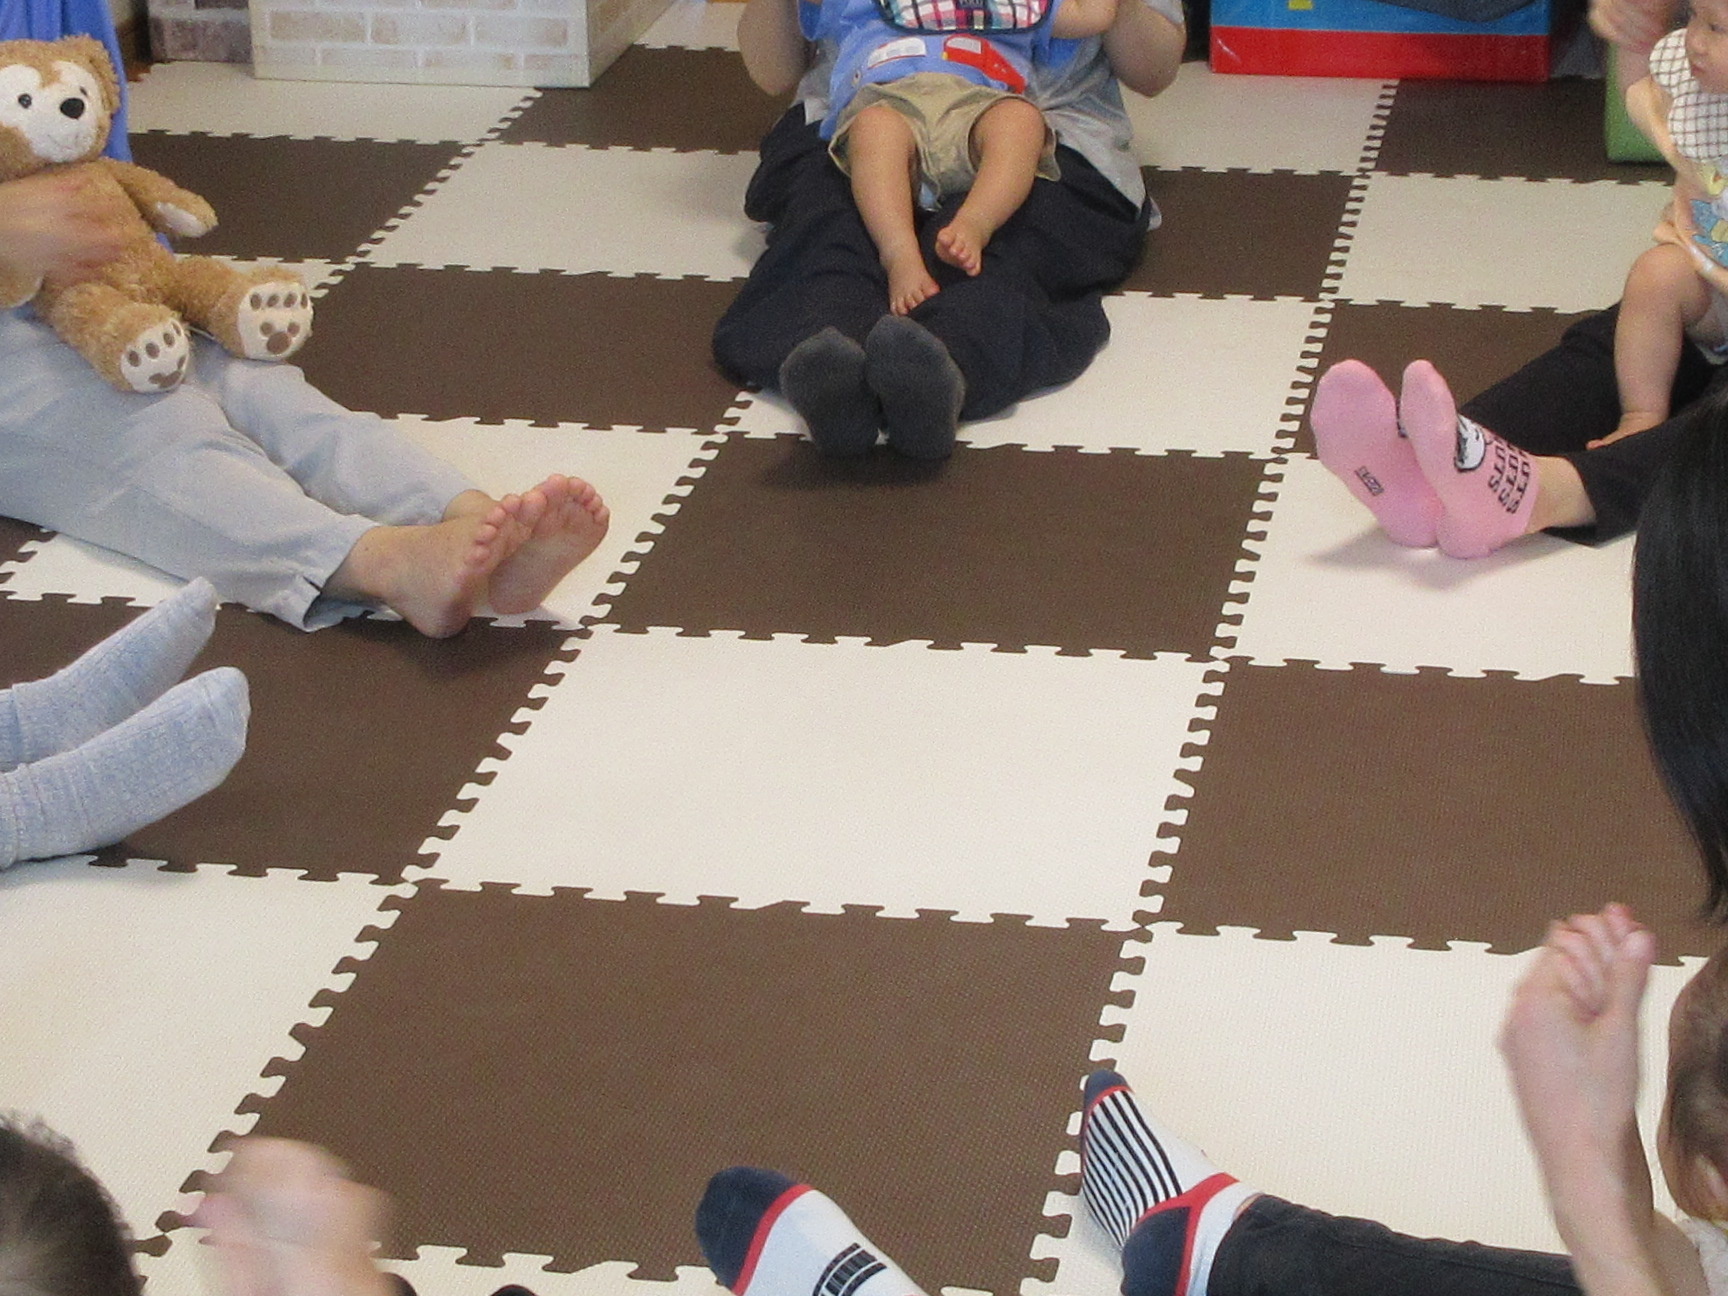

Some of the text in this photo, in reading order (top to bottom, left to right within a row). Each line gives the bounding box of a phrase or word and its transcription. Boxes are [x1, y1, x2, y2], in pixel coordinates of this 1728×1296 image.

[1487, 436, 1507, 493] UTS
[1498, 443, 1520, 507] UTS
[1505, 449, 1532, 515] UTS
